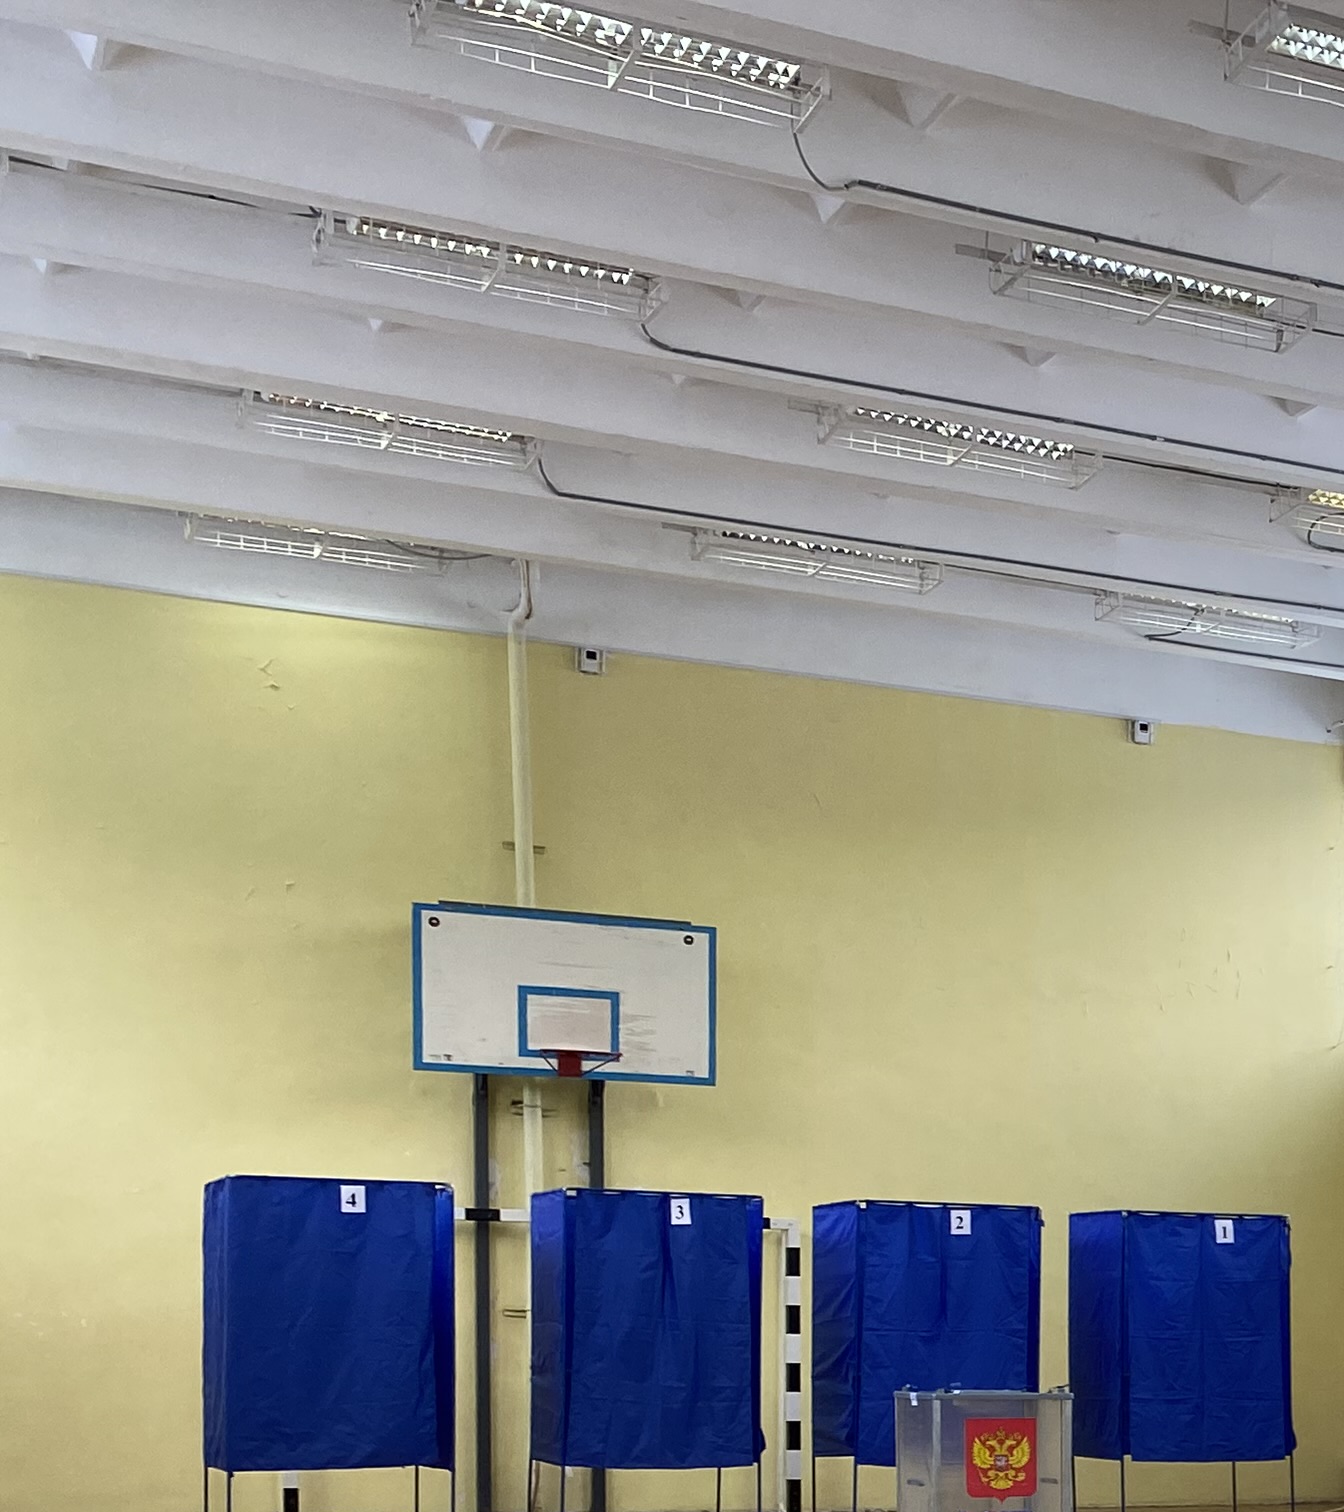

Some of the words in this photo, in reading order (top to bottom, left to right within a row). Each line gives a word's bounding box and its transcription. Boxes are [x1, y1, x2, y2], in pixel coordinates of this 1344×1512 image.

[345, 1193, 357, 1208] 4
[675, 1205, 684, 1220] 3
[955, 1215, 964, 1230] 2
[1221, 1226, 1228, 1239] 1
